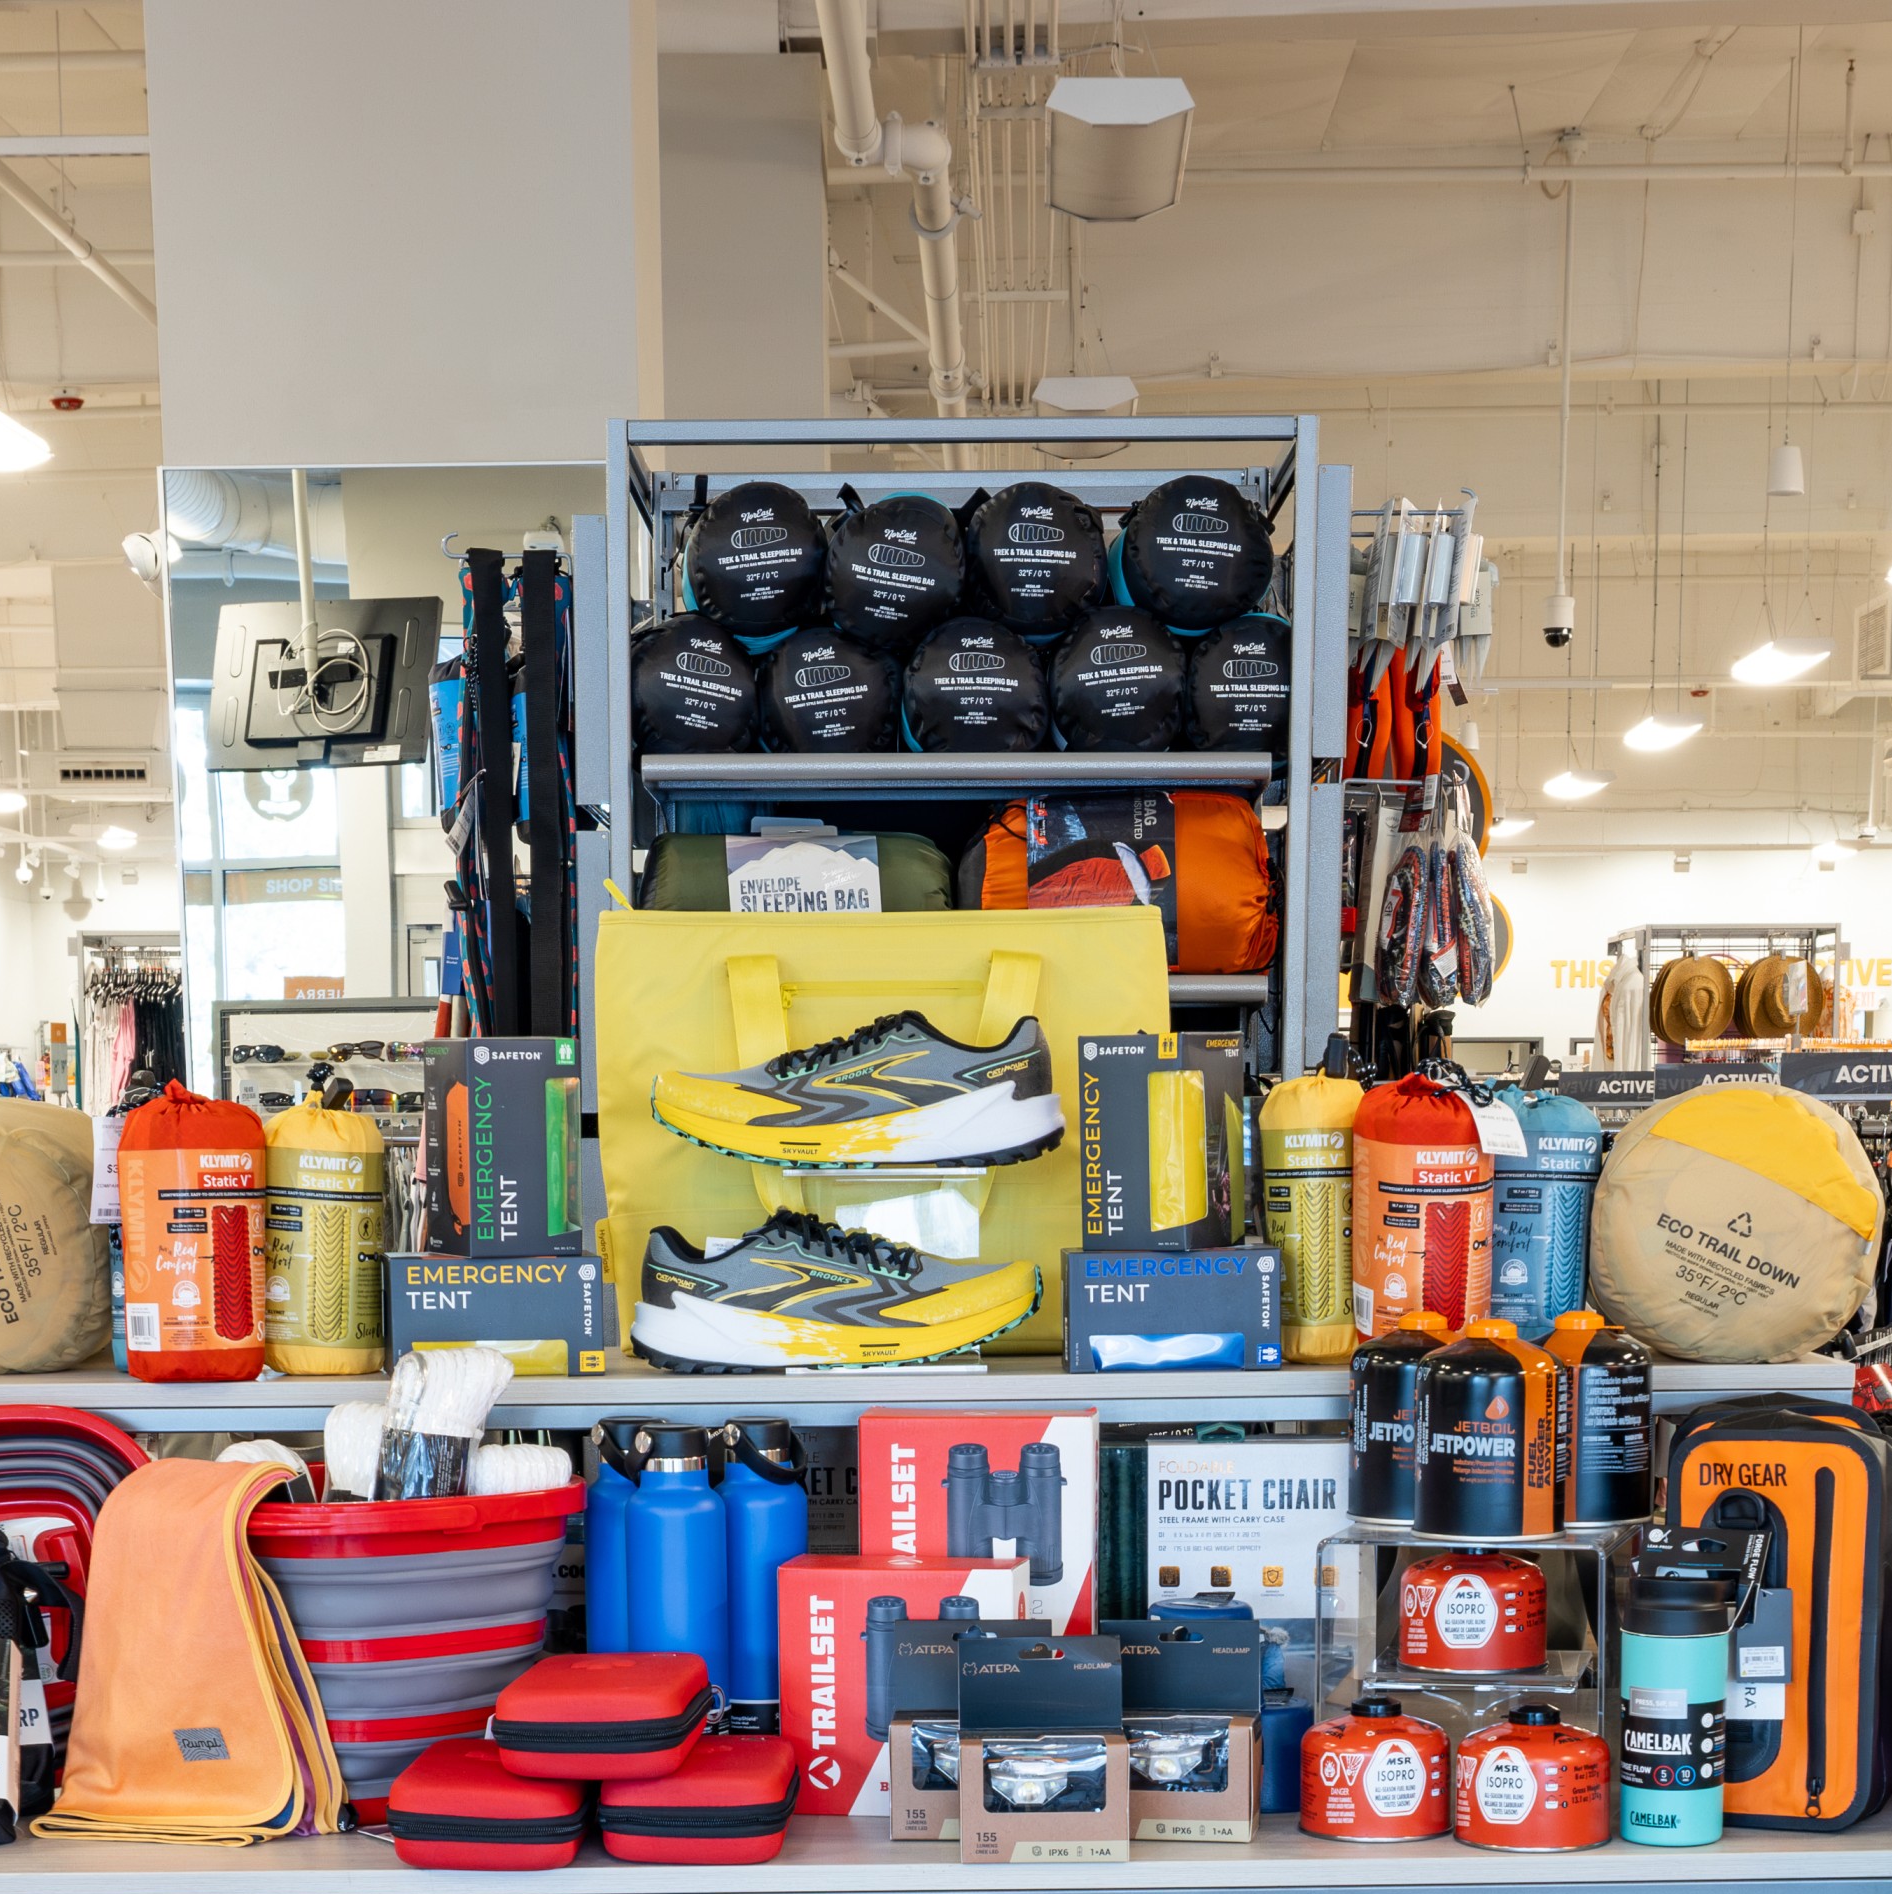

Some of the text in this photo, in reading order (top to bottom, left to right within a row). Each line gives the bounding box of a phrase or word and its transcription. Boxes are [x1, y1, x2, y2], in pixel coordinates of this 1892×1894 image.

[741, 508, 774, 522] NorEast
[718, 556, 733, 565] TREK
[740, 553, 757, 563] TRAIL
[759, 550, 789, 560] SLEEPING
[790, 548, 802, 556] BAG
[740, 877, 801, 895] ENVELOPE
[740, 888, 869, 912] SLEEPING BAG
[491, 1051, 542, 1060] SAFETON
[1099, 1046, 1145, 1055] SAFETON
[835, 1066, 875, 1083] BROOKS
[1084, 1072, 1103, 1234] EMERGENCY
[1538, 1138, 1584, 1151] KLYMIT
[200, 1155, 240, 1169] KLYMIT
[475, 1076, 495, 1241] EMERGENCY
[1416, 1150, 1465, 1164] KLYMIT
[500, 1175, 518, 1241] TENT
[1107, 1170, 1123, 1236] TENT
[1656, 1213, 1800, 1288] ECO TRAIL DOWN
[407, 1264, 567, 1285] EMERGENCY
[601, 1258, 609, 1274] Flask
[1084, 1257, 1248, 1278] EMERGENCY
[1665, 1241, 1775, 1295] MADE WITH RECYCLED FABRICS
[809, 1270, 850, 1285] BROOKS
[406, 1291, 472, 1309] TENT
[1084, 1284, 1149, 1302] TENT
[1454, 1421, 1515, 1435] JETBOIL
[1544, 1373, 1553, 1486] ADVENTURES
[1430, 1433, 1515, 1457] JETPOWER
[1159, 1461, 1235, 1474] FOLDABLE
[1528, 1438, 1537, 1487] FUEL
[1699, 1463, 1787, 1487] DRY GEAR
[1159, 1478, 1336, 1510] POCKET CHAIR
[1455, 1591, 1482, 1599] MSR
[1447, 1603, 1486, 1615] ISOPRO
[811, 1596, 836, 1749] TRAILSET
[979, 1664, 1020, 1673] ATEPA
[1073, 1662, 1111, 1671] HEADLAMP
[182, 1738, 221, 1751] Rumpl
[1624, 1729, 1693, 1756] CAMELBAK
[1387, 1757, 1411, 1765] MSR
[1377, 1769, 1416, 1781] ISOPRO
[975, 1832, 997, 1842] 155
[1048, 1848, 1069, 1856] IPX6
